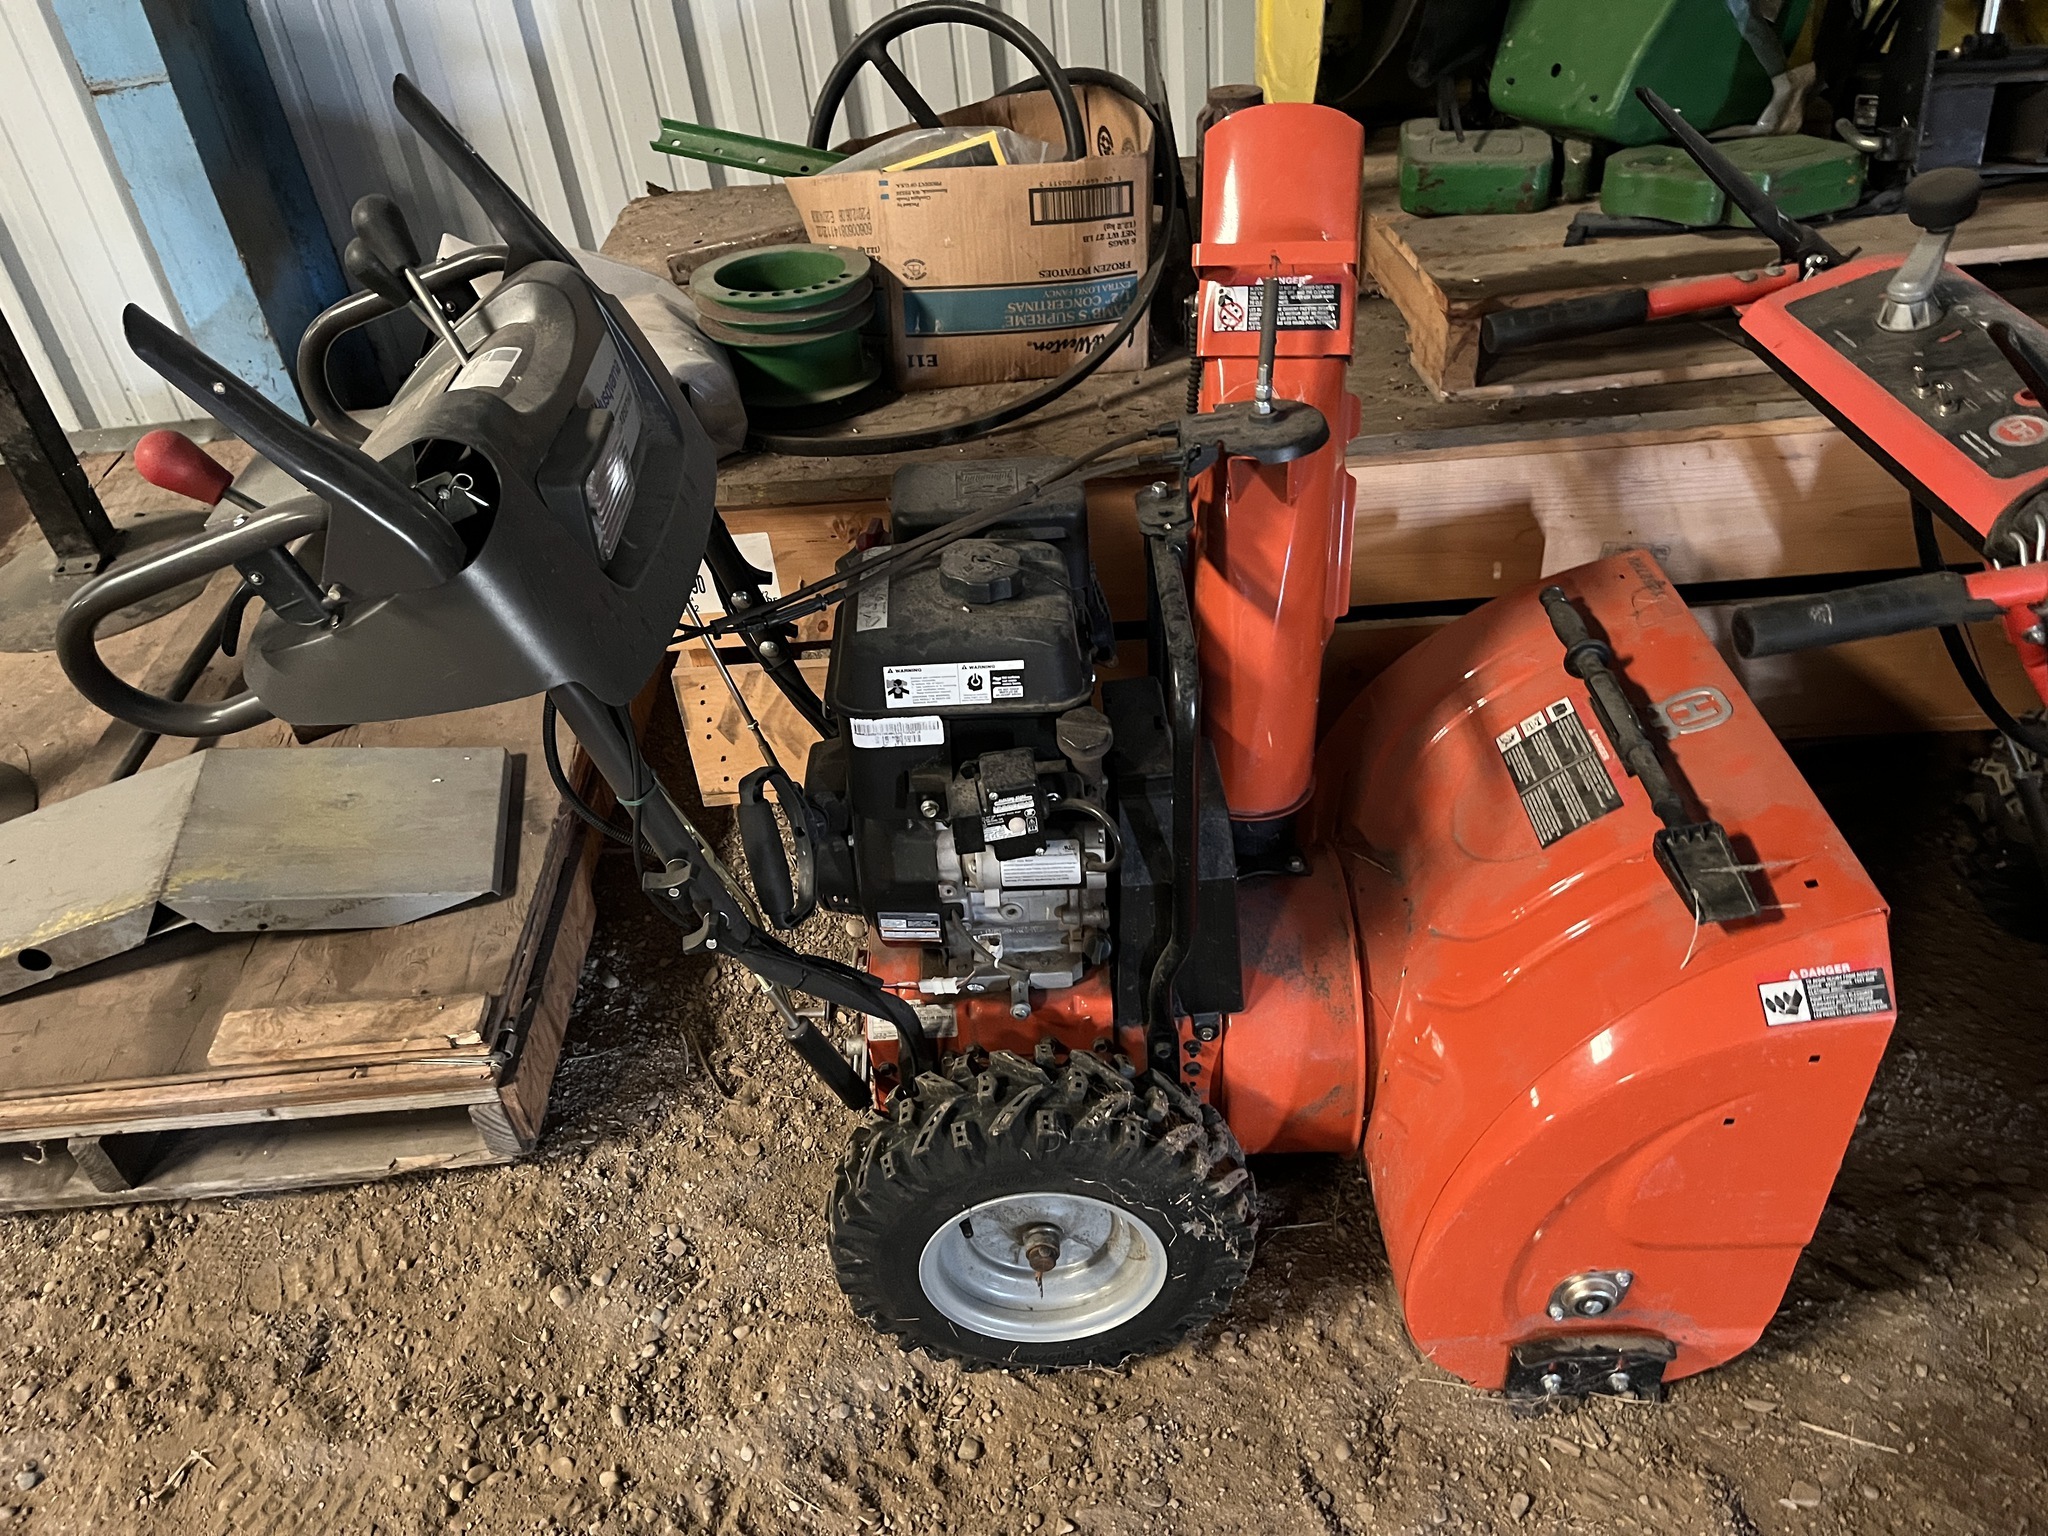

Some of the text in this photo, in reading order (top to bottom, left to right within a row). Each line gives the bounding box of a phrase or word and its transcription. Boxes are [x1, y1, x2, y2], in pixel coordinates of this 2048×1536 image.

[1082, 229, 1137, 243] NET WT 27 LB
[1108, 238, 1130, 248] BAGS
[1038, 260, 1131, 278] FROZEN POTATOES
[1043, 280, 1131, 298] EXTRA LONG FANCY
[1007, 295, 1102, 313] CONCERTINAS
[1004, 303, 1130, 328] LAMB'S SUPREME
[906, 354, 938, 368] E11
[1799, 963, 1850, 979] DANGER
